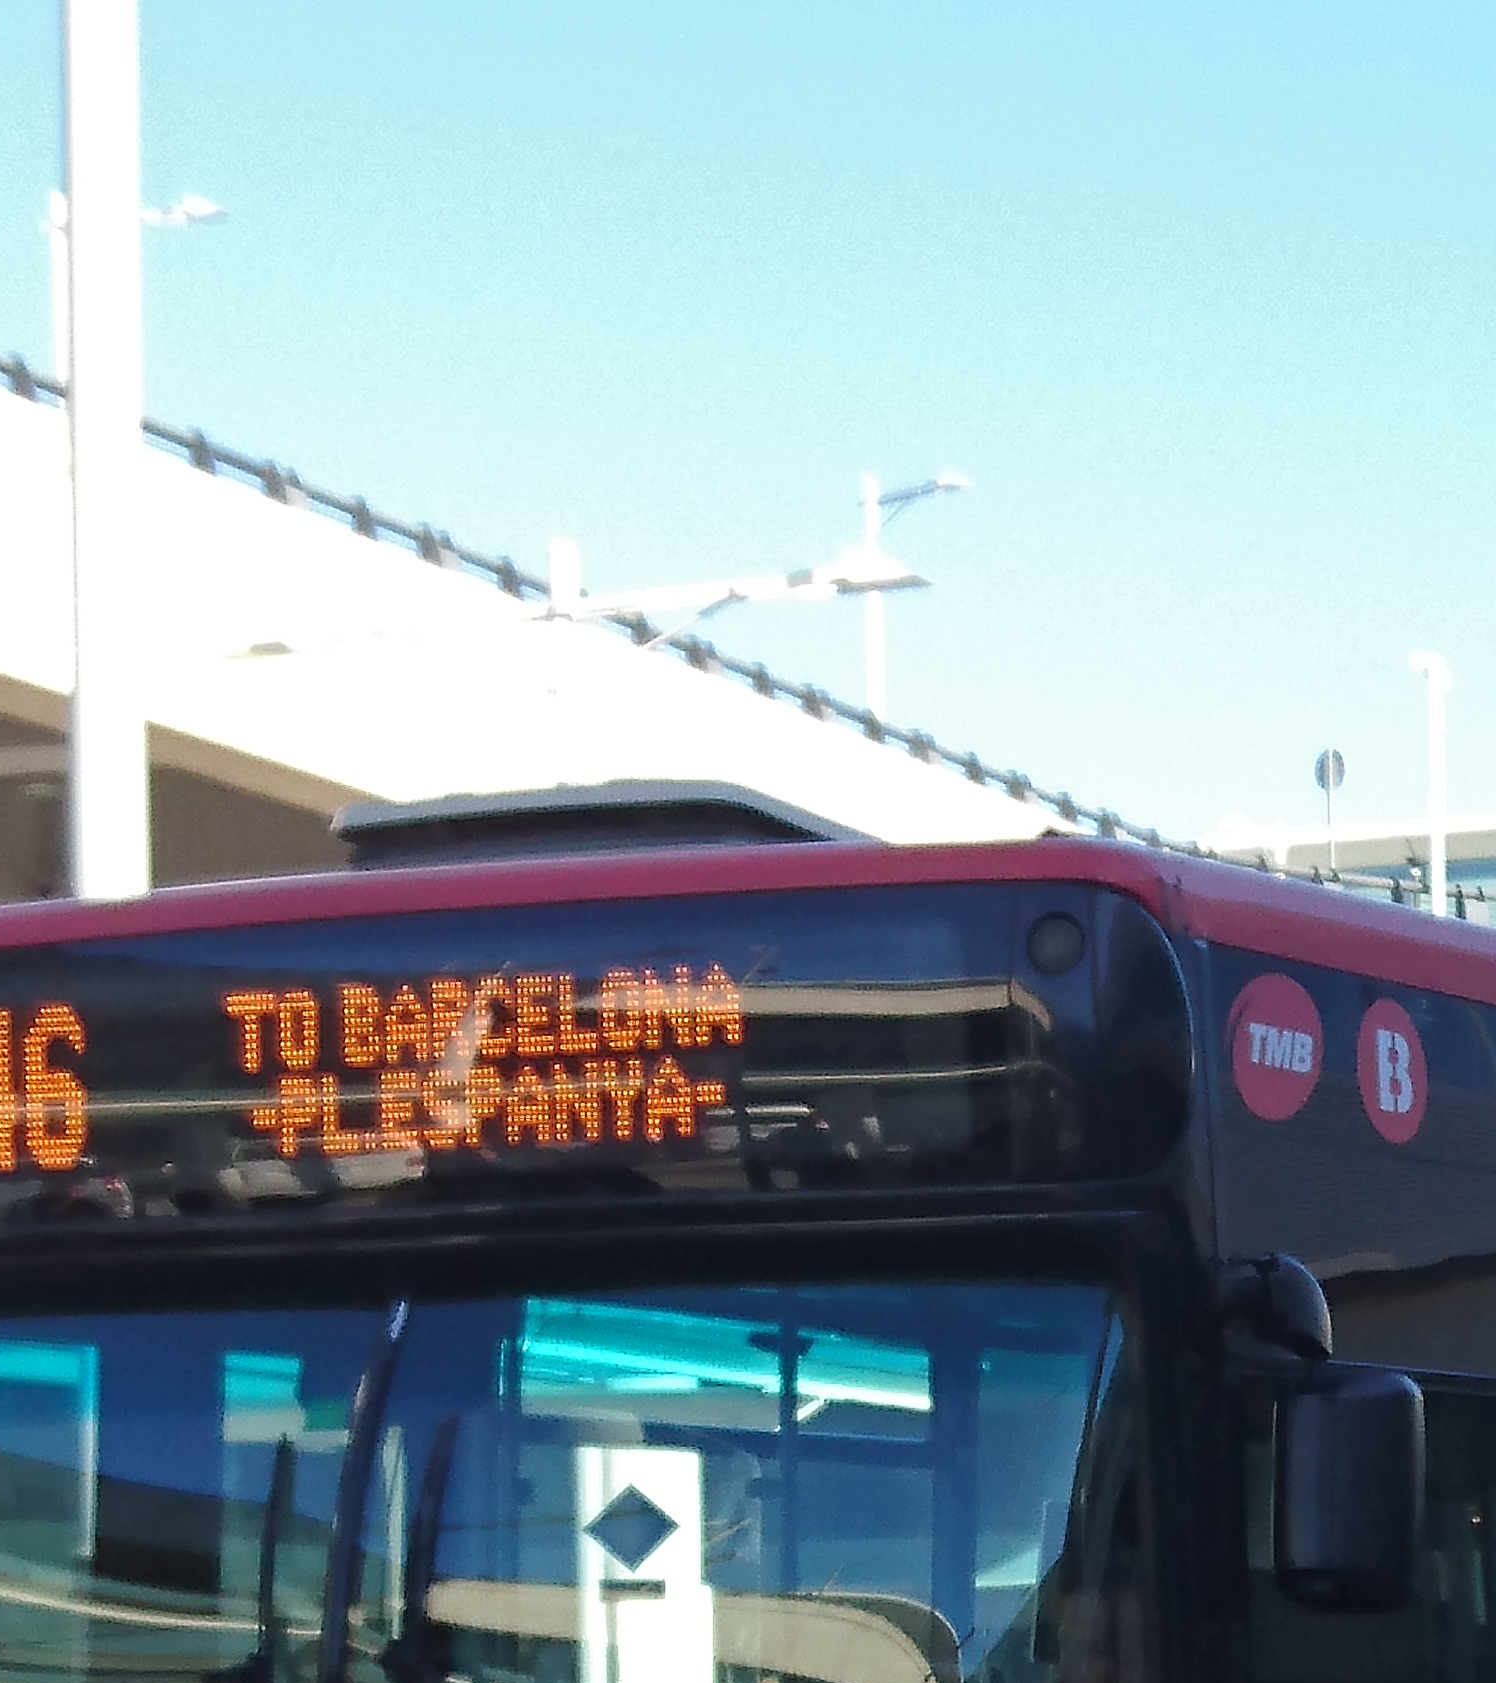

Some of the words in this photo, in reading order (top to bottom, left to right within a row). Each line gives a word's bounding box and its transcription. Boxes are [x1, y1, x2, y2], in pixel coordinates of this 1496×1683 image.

[225, 987, 319, 1074] TO
[342, 961, 744, 1069] BARCELONA
[1248, 1022, 1313, 1073] TMB
[1375, 1028, 1414, 1113] B
